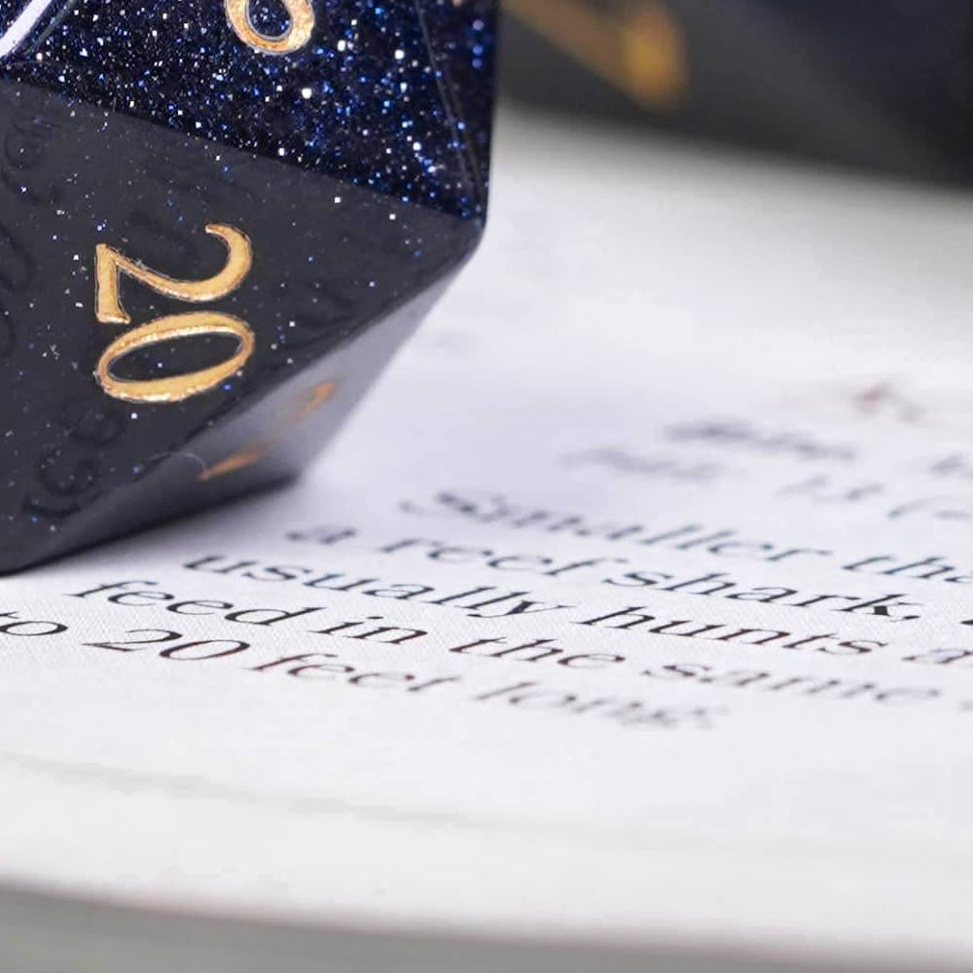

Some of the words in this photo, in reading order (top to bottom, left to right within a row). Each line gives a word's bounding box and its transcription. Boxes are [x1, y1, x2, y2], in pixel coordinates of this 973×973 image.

[93, 223, 256, 404] 20
[64, 579, 327, 627] feed
[308, 615, 429, 645] in
[447, 636, 628, 669] the
[183, 555, 577, 619] usually
[571, 605, 889, 655] hunts
[602, 570, 923, 622] shark,
[81, 628, 252, 662] 20
[243, 652, 464, 693] feet
